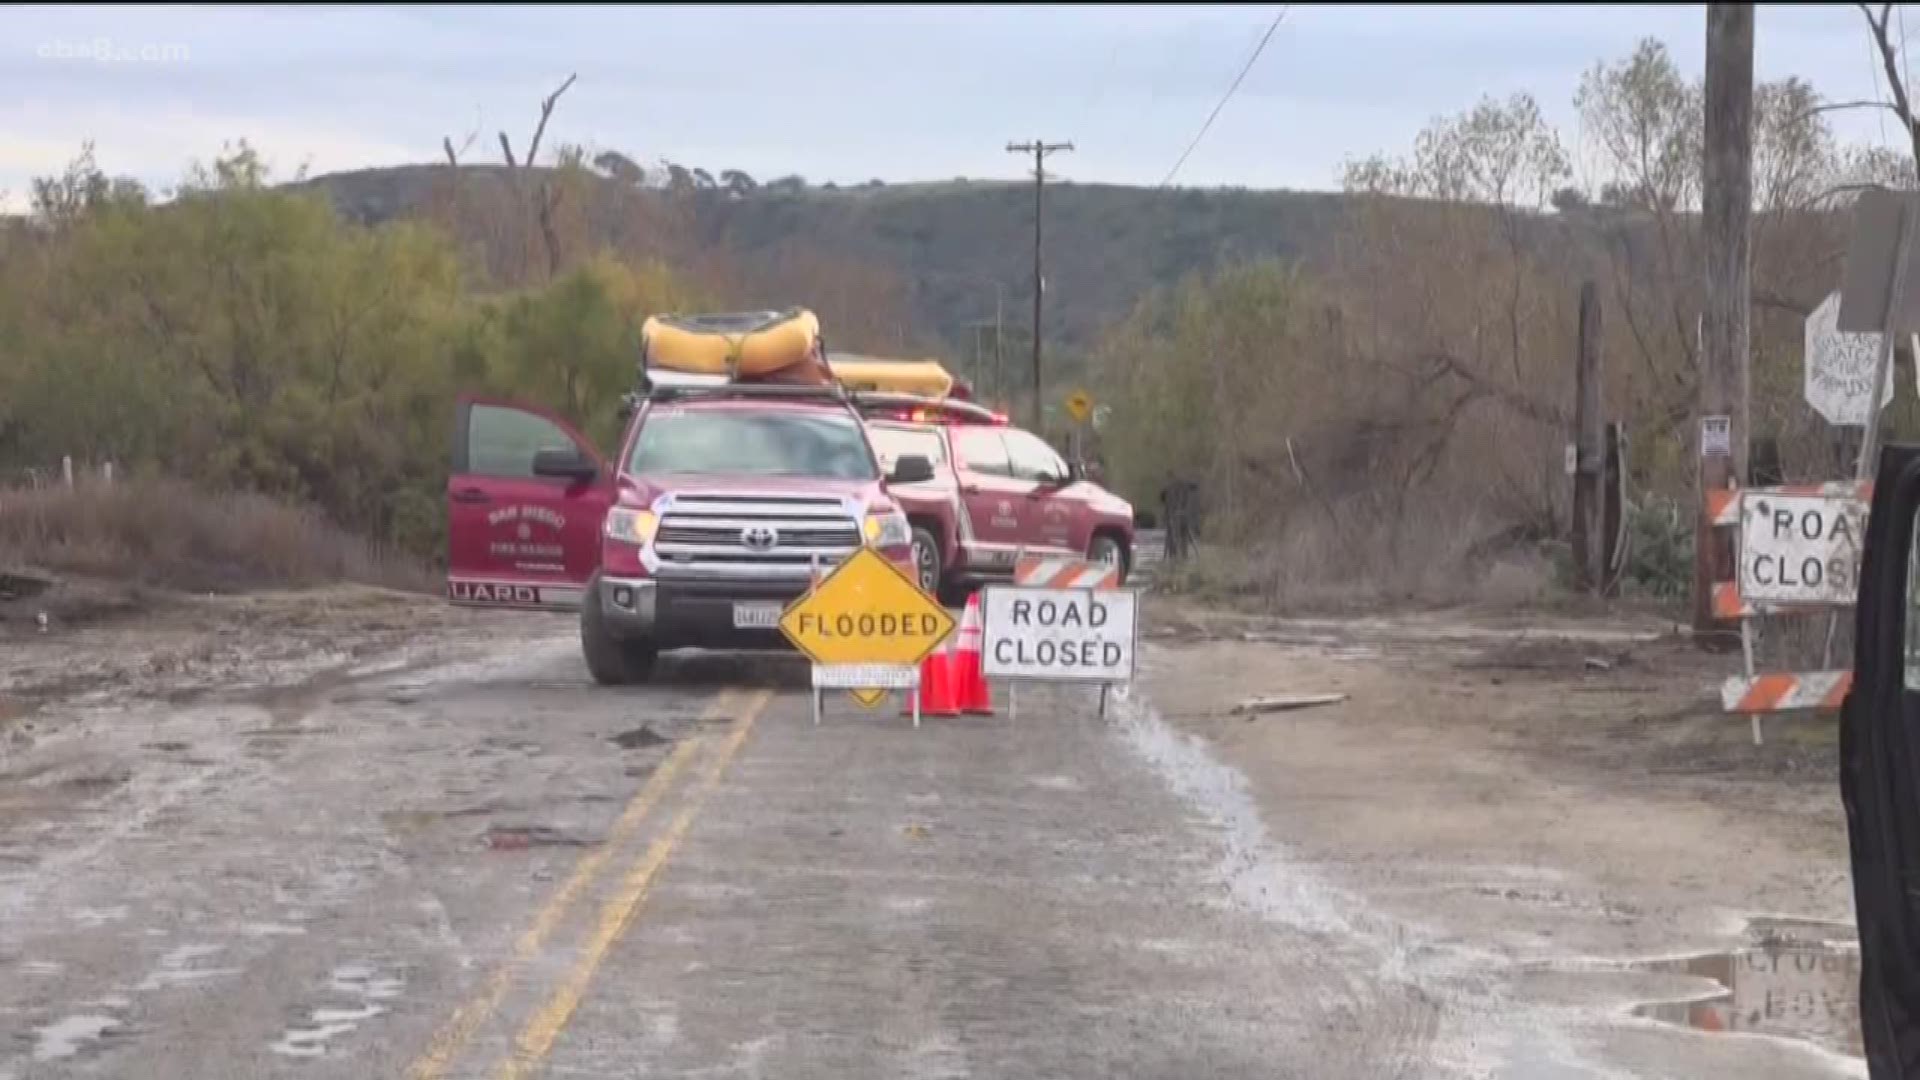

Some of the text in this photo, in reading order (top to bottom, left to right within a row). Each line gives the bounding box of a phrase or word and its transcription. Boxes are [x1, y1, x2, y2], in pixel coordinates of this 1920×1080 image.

[488, 504, 565, 529] SAN DIEGO
[1774, 509, 1870, 547] ROA
[1753, 554, 1860, 588] CLOS
[799, 613, 939, 637] FLOODED
[1013, 600, 1107, 627] ROAD
[995, 638, 1121, 667] CLOSED
